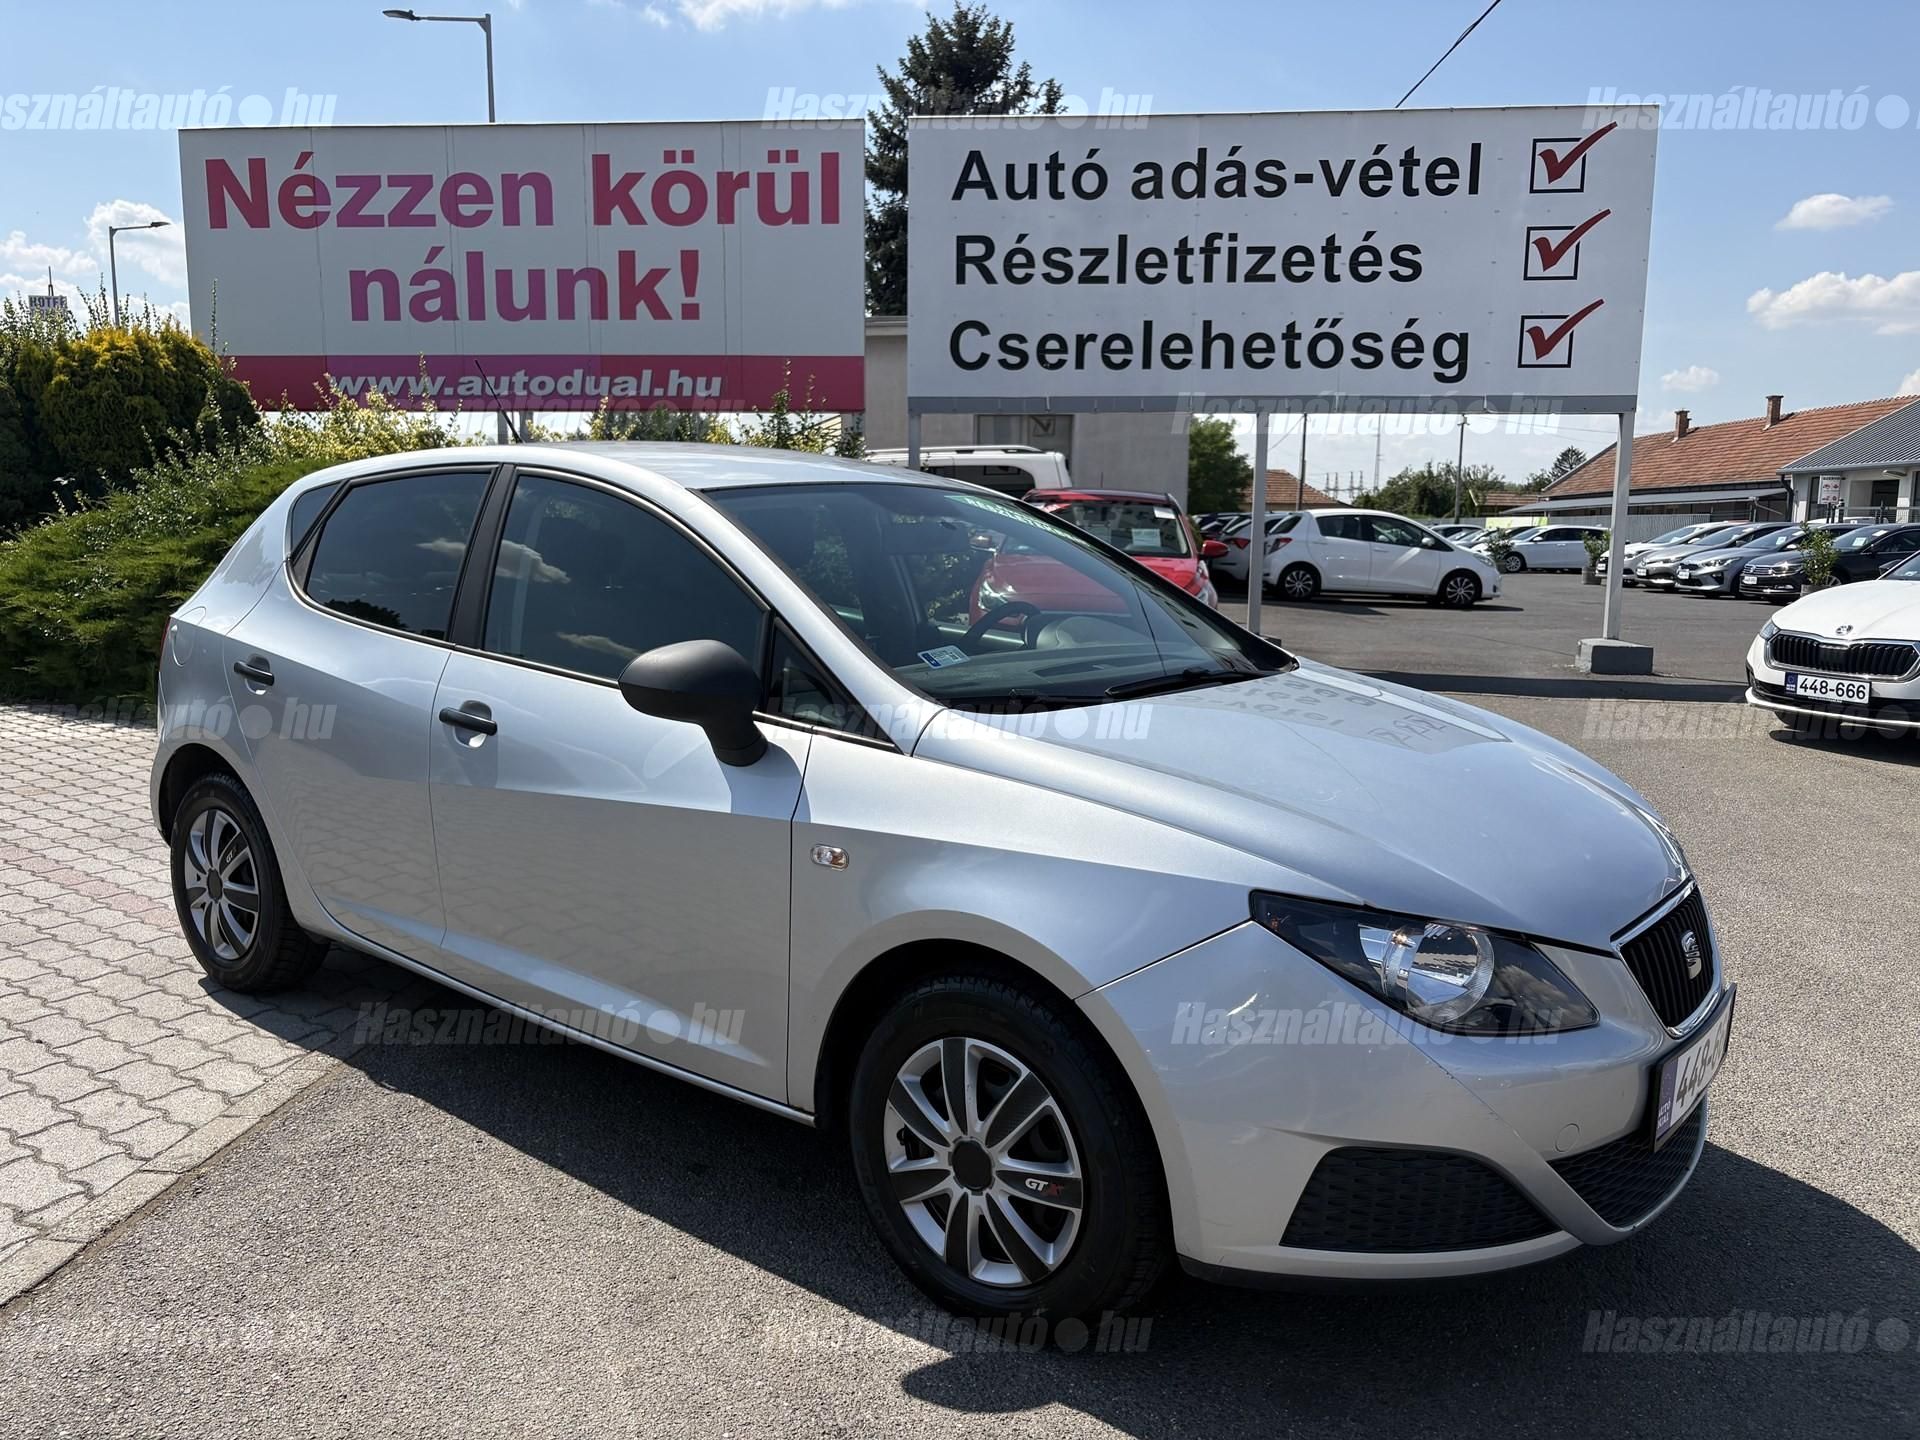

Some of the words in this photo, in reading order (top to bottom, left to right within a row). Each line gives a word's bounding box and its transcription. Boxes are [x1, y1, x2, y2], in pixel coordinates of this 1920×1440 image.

[206, 152, 555, 229] Nézzen
[592, 150, 840, 226] körül
[952, 148, 1108, 200] Autó
[1132, 143, 1482, 200] adás-vétel
[350, 246, 702, 322] nálunk!
[956, 231, 1423, 285] Részletfizetés
[950, 318, 1469, 384] Cserelehetőség
[331, 368, 721, 397] www.autodual.hu
[1799, 677, 1866, 700] 448-666
